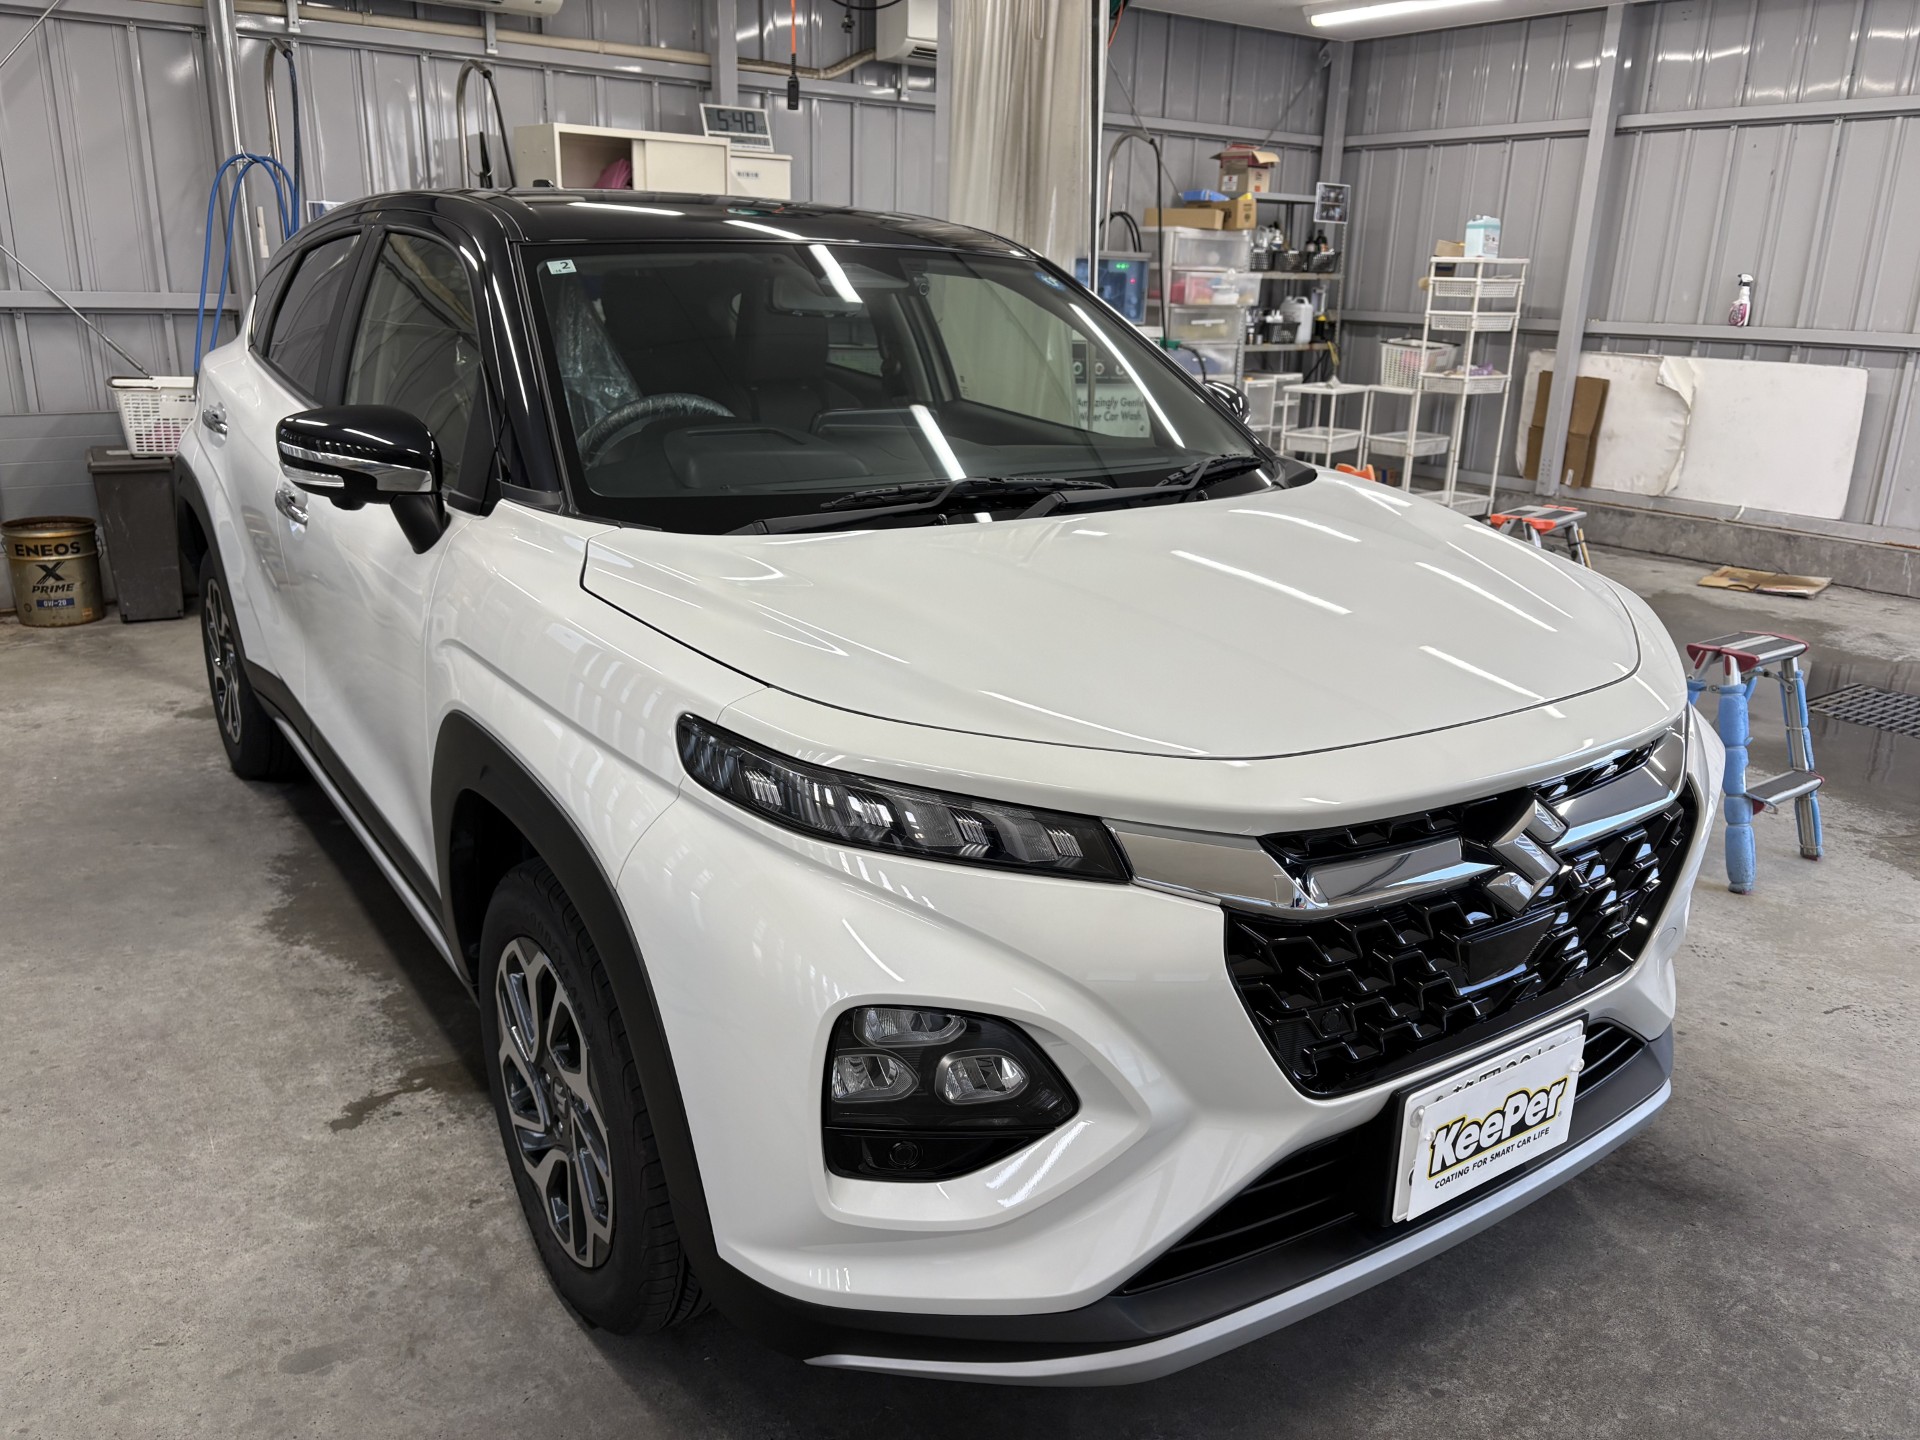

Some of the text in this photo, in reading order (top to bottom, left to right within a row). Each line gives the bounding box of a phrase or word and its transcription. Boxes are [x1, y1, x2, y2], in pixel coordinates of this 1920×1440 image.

[560, 261, 570, 270] 2
[1077, 396, 1118, 409] Amzingly
[1104, 410, 1119, 421] Car
[14, 541, 81, 557] ENEOS
[36, 561, 65, 584] X
[32, 583, 74, 593] PRIME
[1428, 1077, 1568, 1179] KeePer
[1434, 1127, 1550, 1189] COATING FOR SMART CAR LIFE
